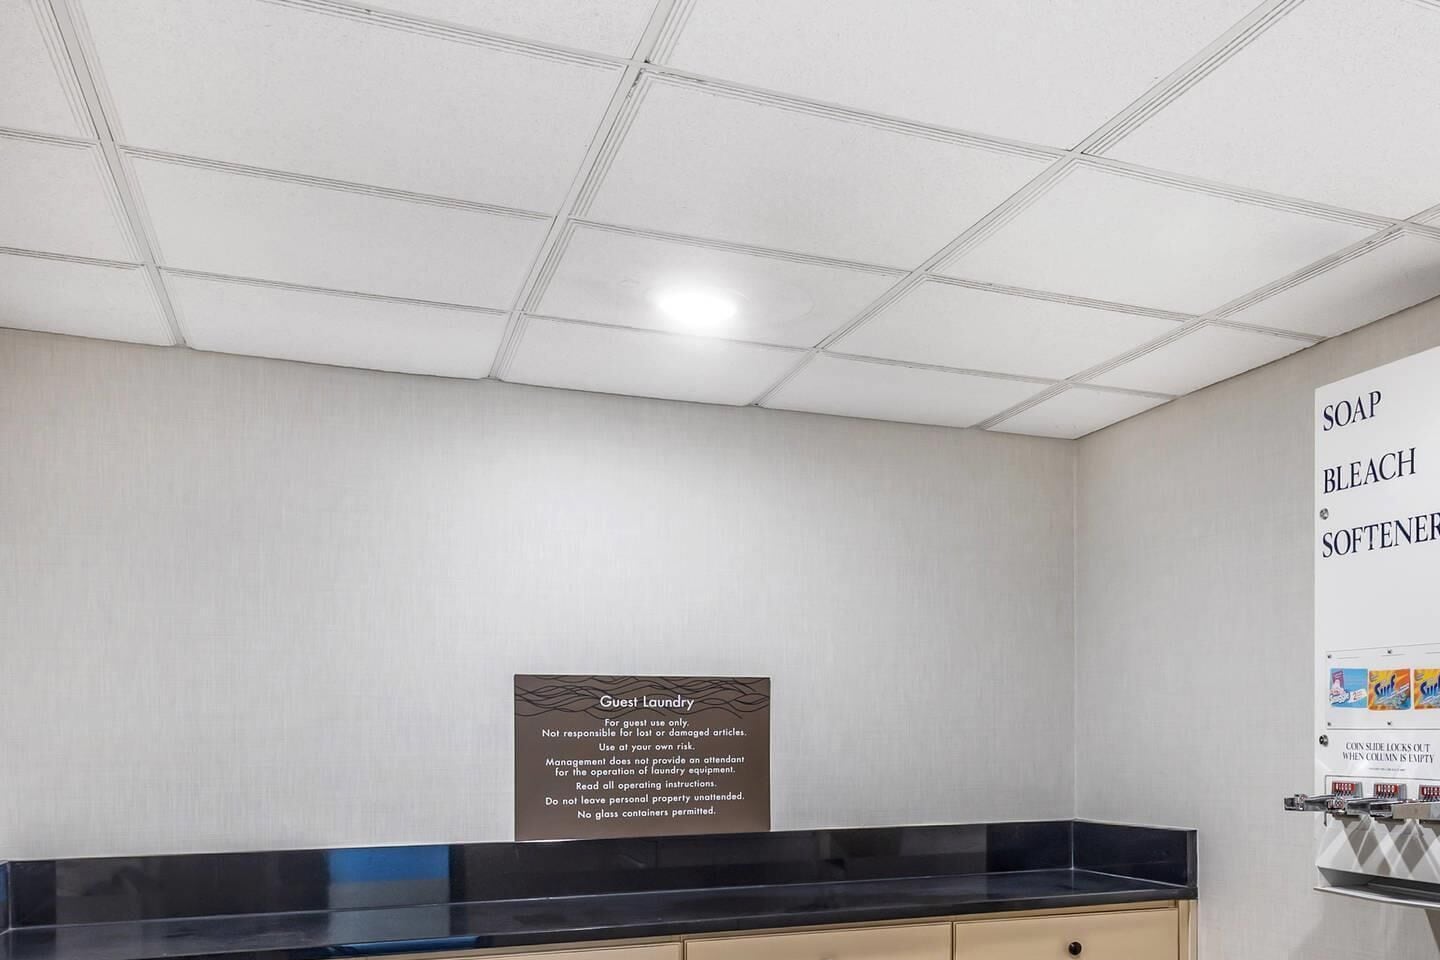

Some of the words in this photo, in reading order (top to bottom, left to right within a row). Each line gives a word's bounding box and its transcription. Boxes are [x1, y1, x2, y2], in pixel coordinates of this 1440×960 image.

[1322, 390, 1382, 432] SOAP
[1322, 447, 1417, 494] BLEACH
[1374, 674, 1396, 698] Surf
[600, 695, 638, 708] Guest
[643, 694, 694, 711] Laundry
[604, 719, 619, 727] For
[623, 719, 647, 729] guest
[668, 717, 690, 729] only.
[542, 729, 560, 737] Not
[563, 728, 616, 739] responsible
[619, 728, 633, 737] for
[636, 727, 652, 737] lost
[655, 729, 665, 737] or
[668, 727, 710, 739] damaged
[713, 727, 747, 737] articles.
[598, 743, 616, 751] Use
[618, 743, 628, 751] at
[631, 744, 652, 753] your
[677, 741, 695, 751] risk.
[1345, 742, 1364, 751] COIN
[1365, 742, 1385, 752] SLIDE
[1386, 743, 1412, 753] LOCKS
[1413, 743, 1431, 753] OUT
[545, 757, 606, 768] Management
[609, 756, 631, 766] does
[634, 757, 649, 765] not
[652, 755, 686, 767] provide
[689, 756, 700, 764] an
[703, 754, 745, 764] attendant
[1342, 751, 1364, 761] WHEN
[1366, 752, 1398, 762] COLUMN
[1400, 753, 1407, 763] IS
[1409, 754, 1434, 764] EMPTY
[555, 767, 569, 777] for
[572, 767, 587, 776] the
[590, 767, 635, 778] operation
[638, 766, 648, 775] of
[651, 765, 685, 776] laundry
[688, 766, 736, 776] equipment.
[576, 781, 599, 790] Read
[602, 780, 614, 790] all
[617, 780, 662, 791] operating
[665, 779, 718, 788] instructions.
[545, 796, 559, 806] Do
[562, 797, 577, 805] not
[581, 795, 606, 805] leave
[609, 793, 649, 806] personal
[652, 794, 690, 805] property
[694, 791, 745, 801] unattended.
[577, 810, 592, 819] No
[595, 808, 619, 820] glass
[622, 808, 669, 818] containers
[671, 805, 716, 818] permitted.
